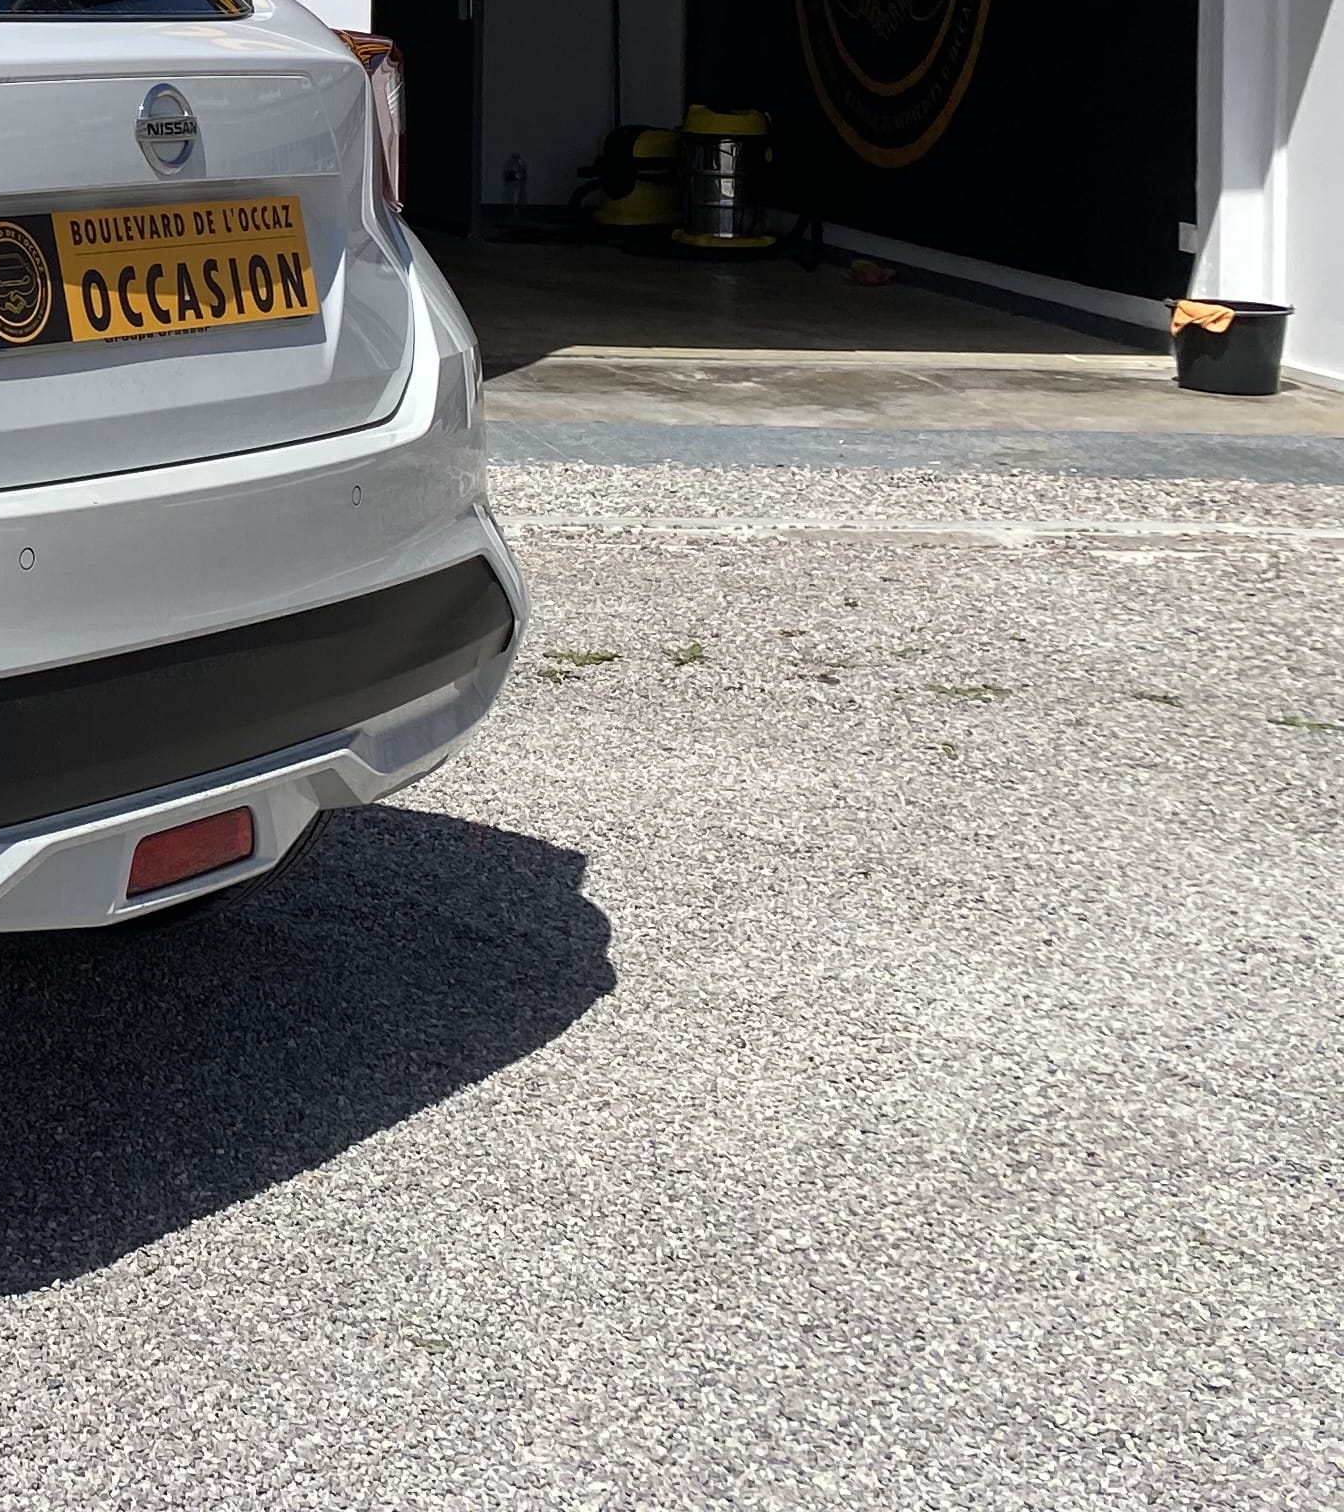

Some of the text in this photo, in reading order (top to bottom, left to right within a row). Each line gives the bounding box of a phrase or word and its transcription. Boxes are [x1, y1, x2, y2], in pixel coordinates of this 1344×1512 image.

[147, 121, 197, 136] NISSAN
[68, 204, 294, 246] BOULEVARD DE L'OCCAZ
[81, 252, 308, 333] OCCASION
